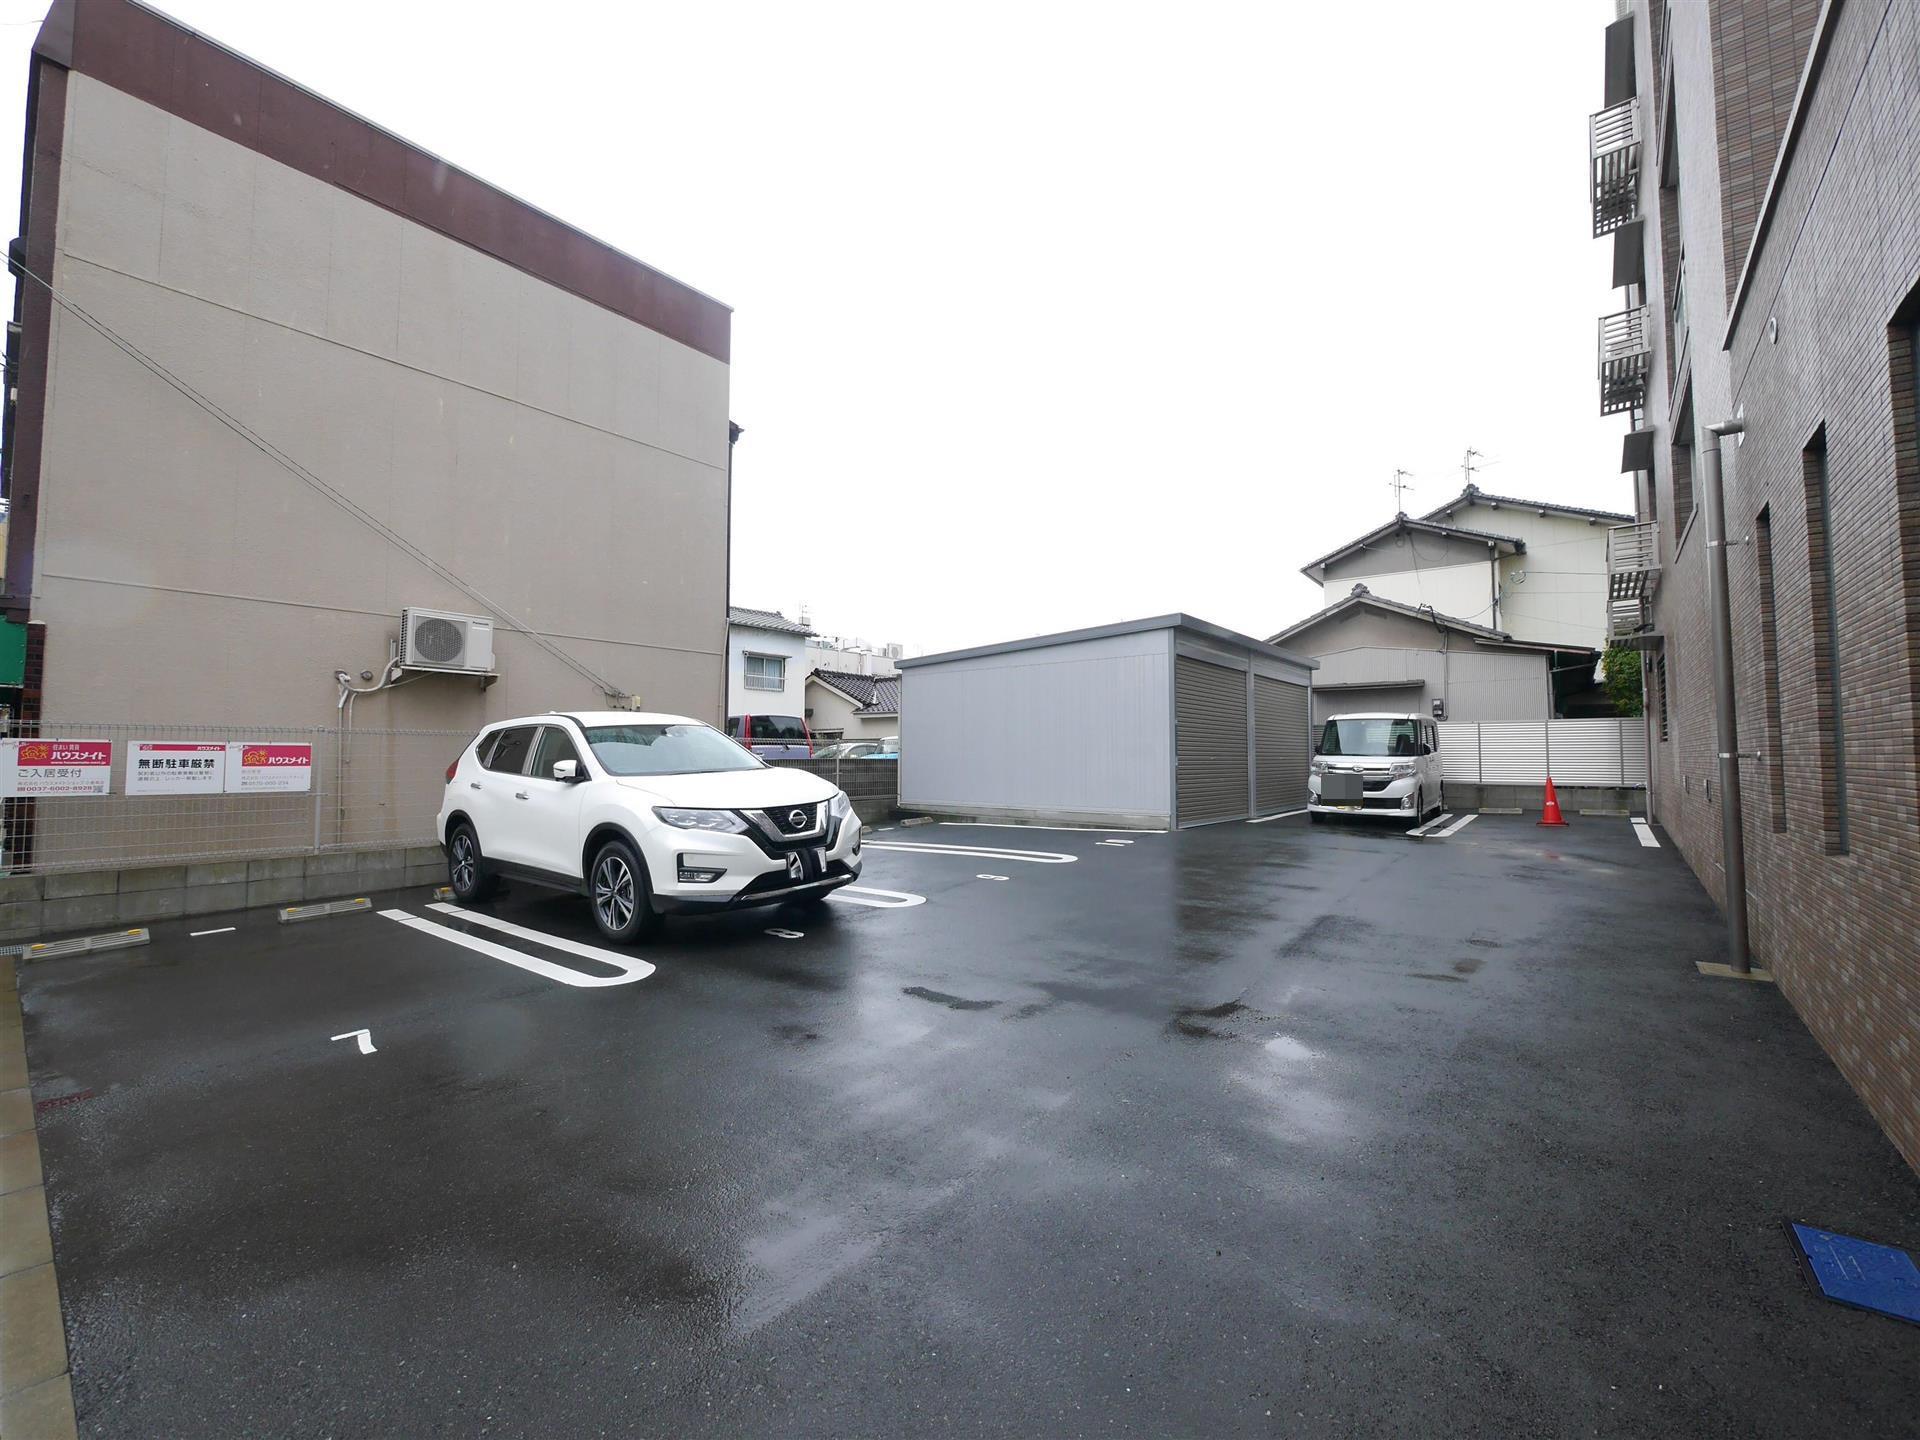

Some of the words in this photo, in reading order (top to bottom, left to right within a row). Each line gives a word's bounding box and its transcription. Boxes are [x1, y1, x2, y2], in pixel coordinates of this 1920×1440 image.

[50, 751, 107, 760] ハウスメイト
[267, 756, 309, 765] ハウスメイト
[138, 758, 215, 769] 無断駐車厳禁
[18, 768, 82, 778] ご入居受付
[764, 928, 805, 939] 8
[330, 1028, 378, 1055] 7
